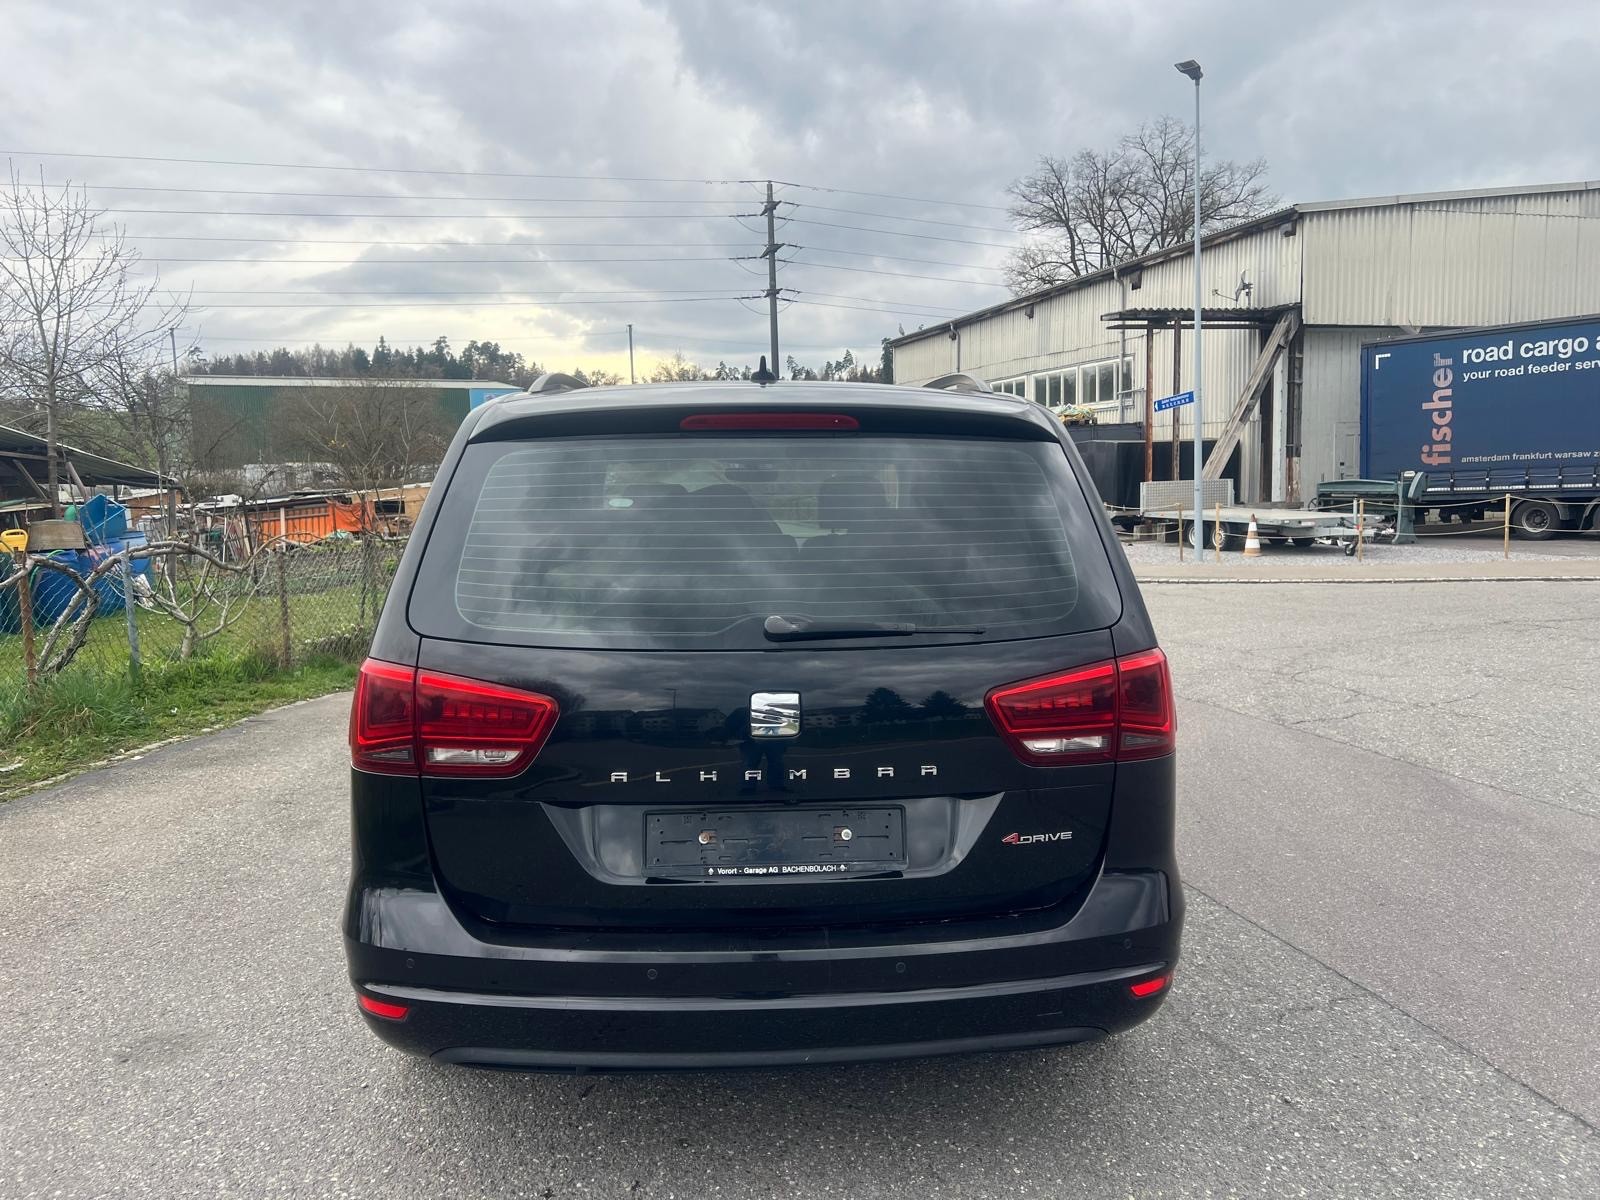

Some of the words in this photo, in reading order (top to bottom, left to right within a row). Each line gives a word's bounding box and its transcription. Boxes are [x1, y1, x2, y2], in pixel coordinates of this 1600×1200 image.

[1463, 341, 1514, 364] road
[1520, 336, 1589, 359] cargo
[1463, 370, 1491, 382] your
[1495, 365, 1524, 378] road
[1528, 361, 1571, 374] feeder
[1421, 352, 1453, 466] fischer
[1461, 453, 1510, 463] amsterdam
[1512, 451, 1552, 461] frankfurt
[1554, 450, 1592, 459] warsaw
[610, 765, 938, 783] ALHAMBRA
[1001, 831, 1073, 845] 4DRIVE
[743, 867, 767, 875] Garage
